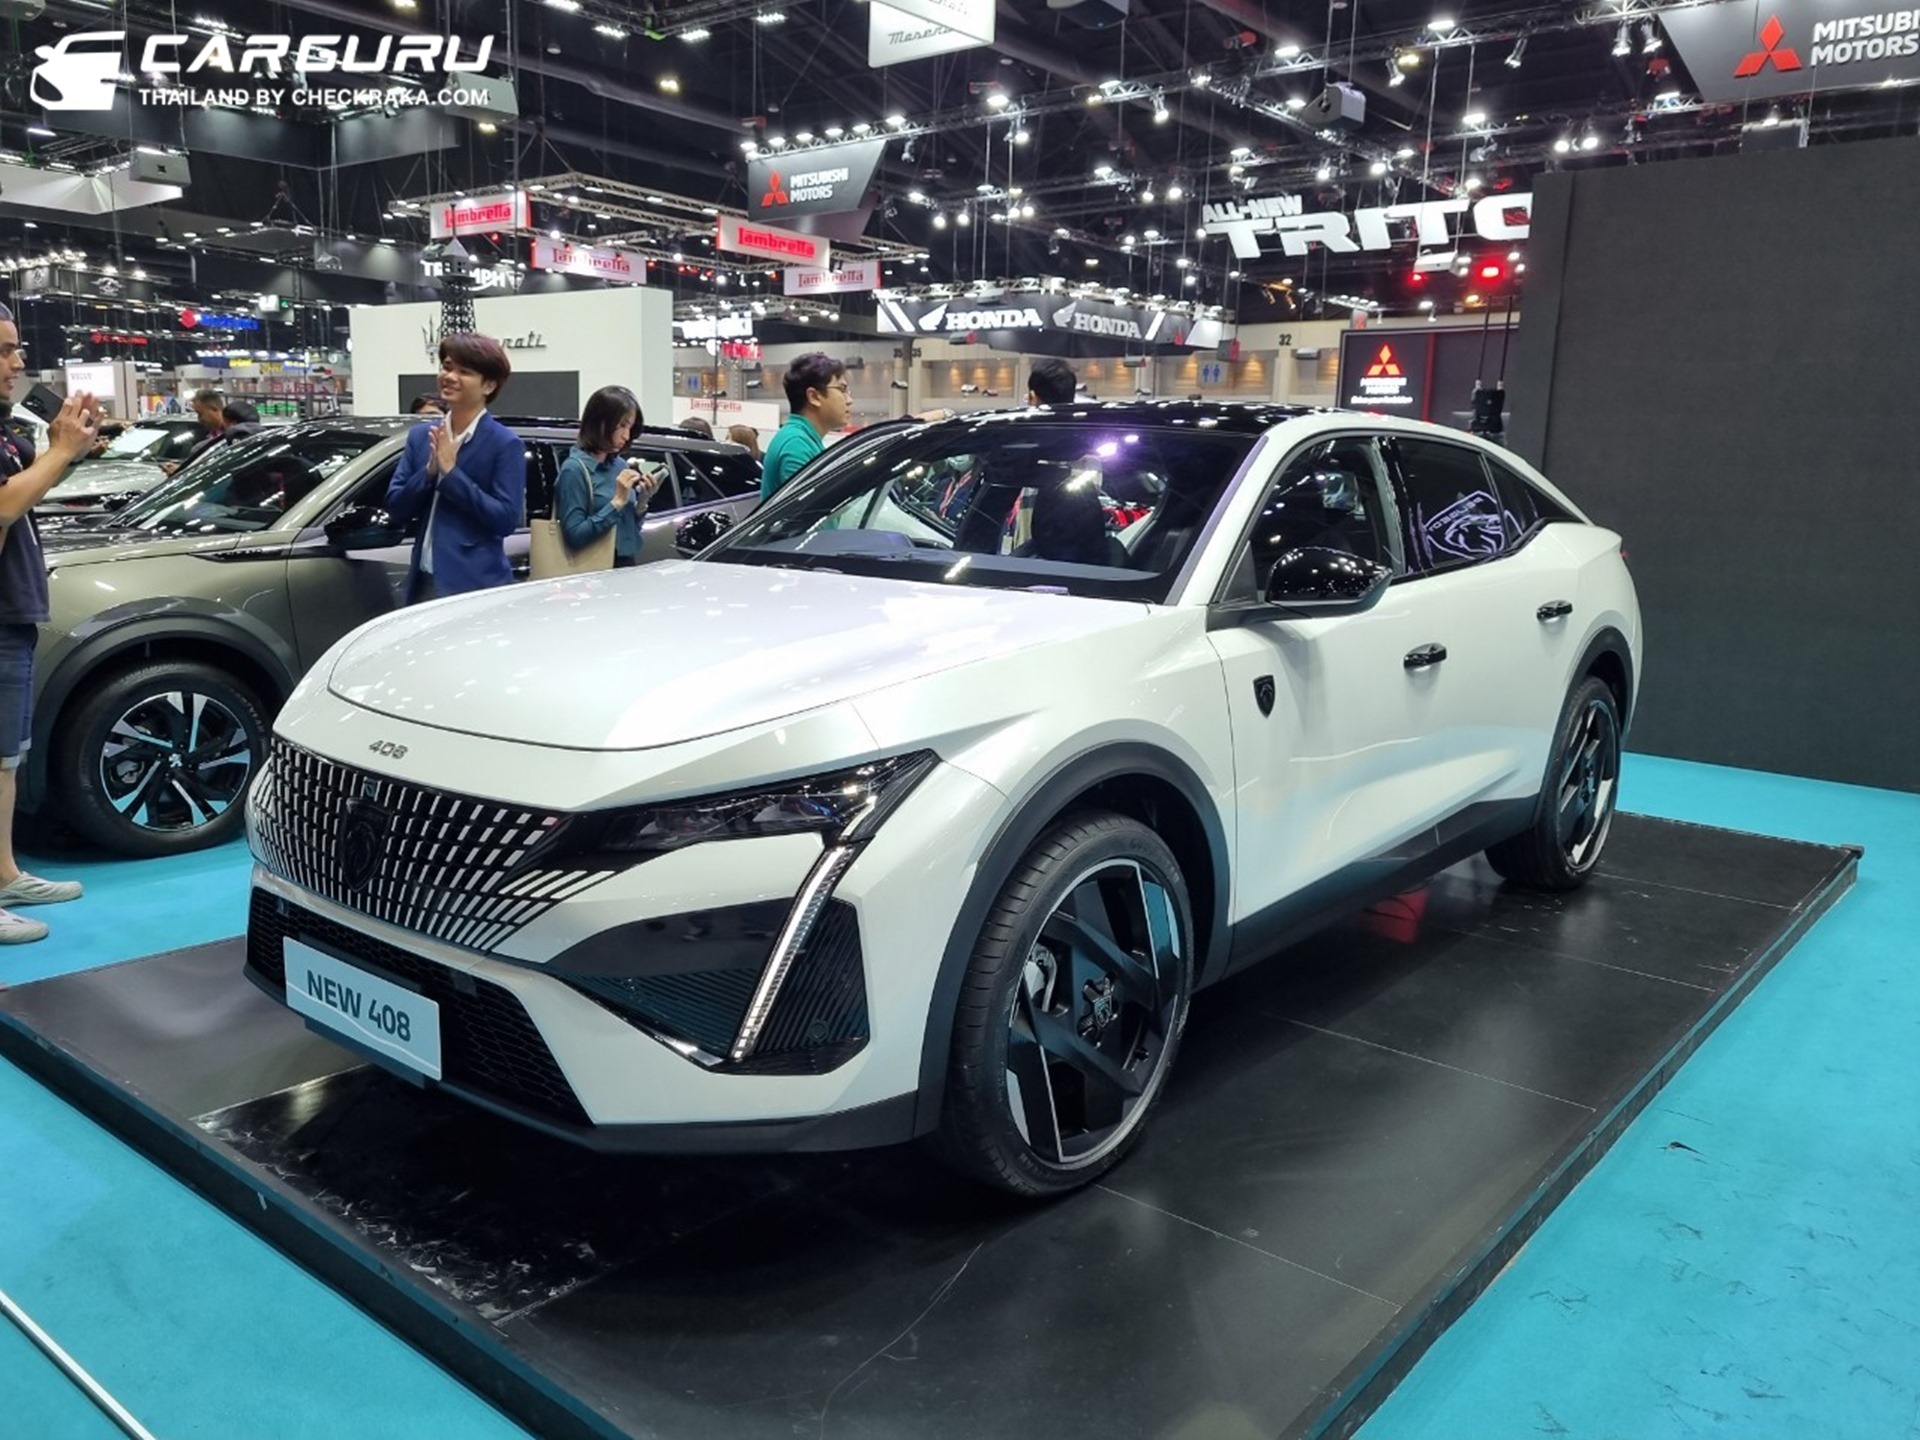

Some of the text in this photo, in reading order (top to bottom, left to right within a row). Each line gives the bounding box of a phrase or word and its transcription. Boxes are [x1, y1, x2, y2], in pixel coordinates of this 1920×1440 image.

[888, 26, 954, 45] Masera
[1813, 9, 1920, 43] MITSUBI
[1810, 33, 1919, 67] MOTORS
[790, 167, 849, 189] MITSUBISHI
[790, 184, 833, 203] MOTORS
[444, 202, 512, 228] Lmbretta
[1202, 195, 1302, 223] ALL-NEW
[1205, 193, 1533, 258] TRITO
[420, 259, 506, 289] TRMPH
[945, 308, 1043, 331] HONDA
[1074, 312, 1141, 338] HONDA
[1278, 333, 1292, 346] 32
[368, 739, 409, 760] 408
[306, 969, 411, 1042] NEW 408
